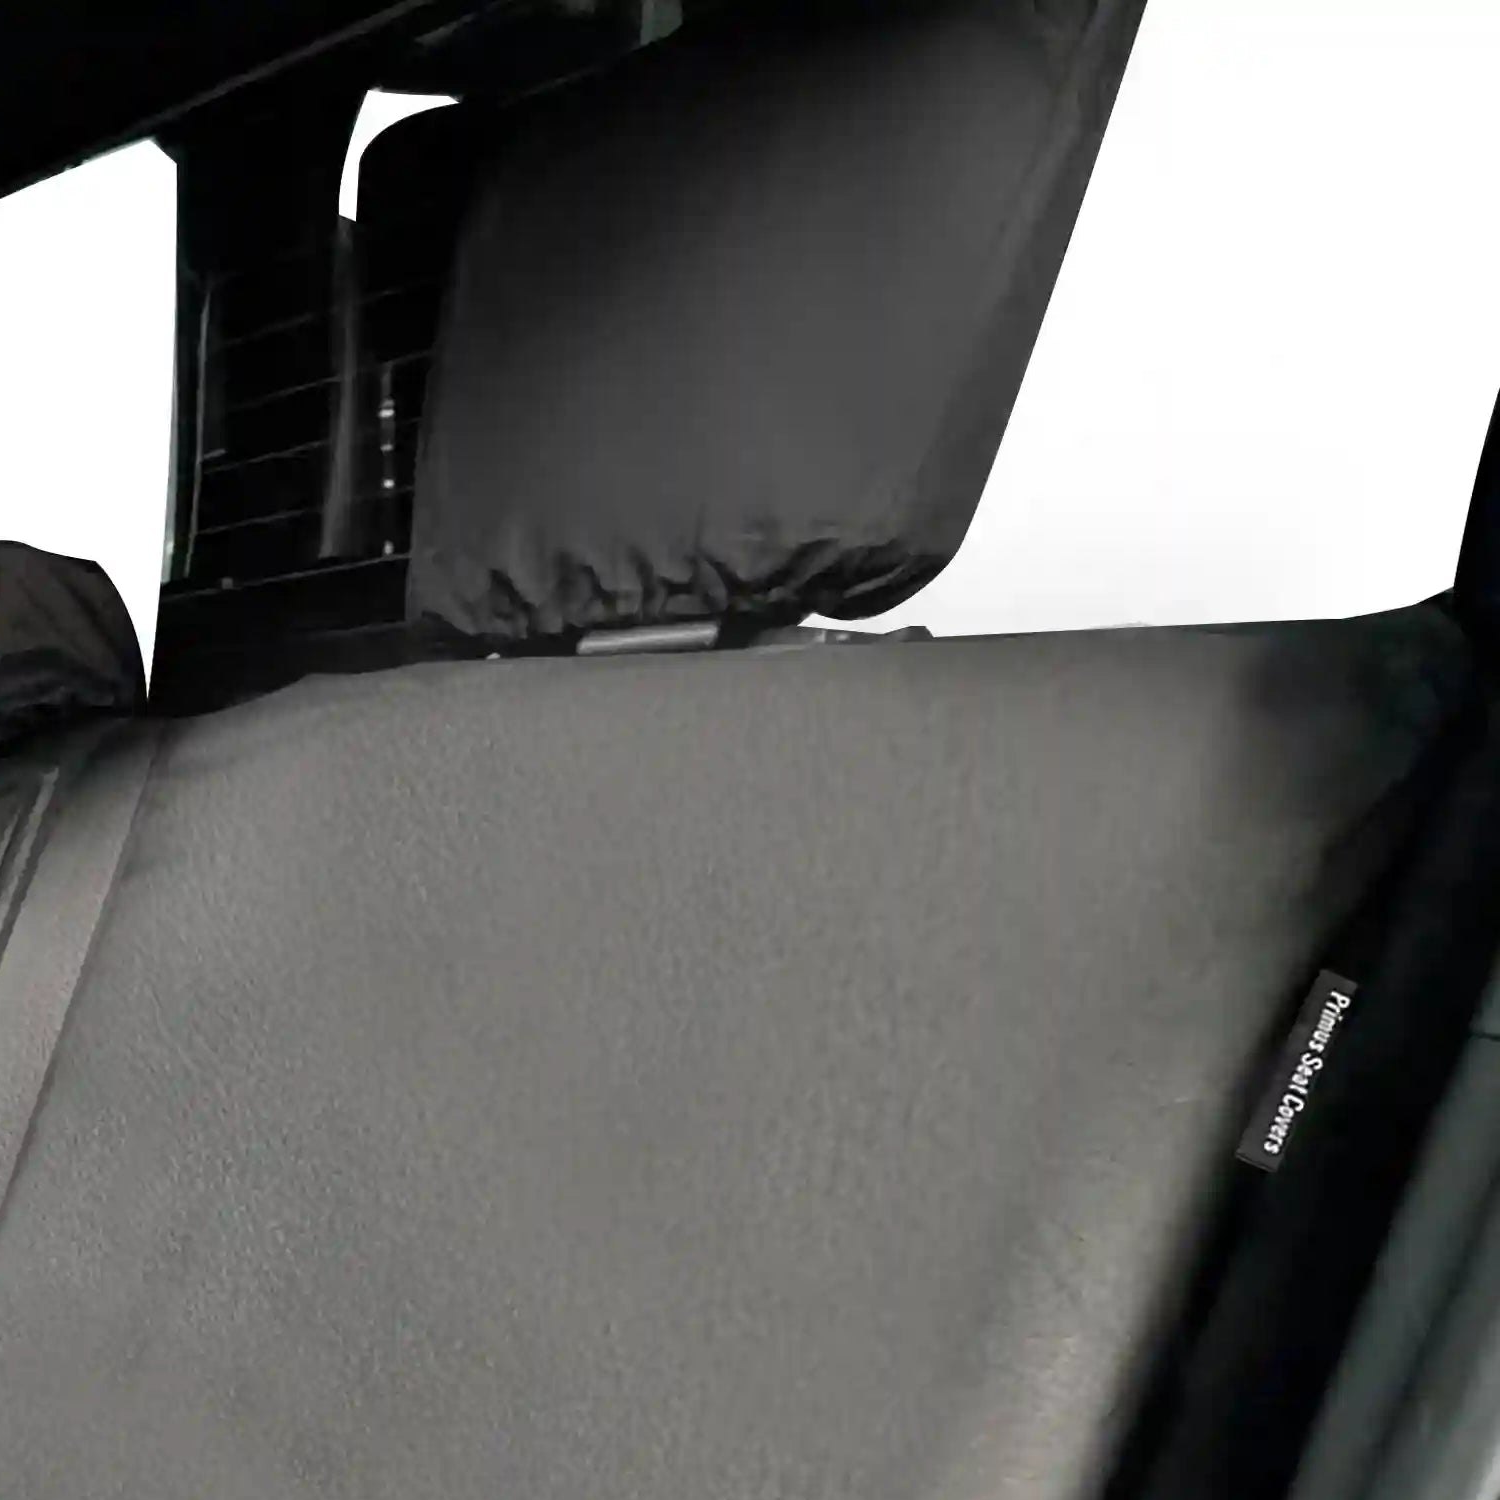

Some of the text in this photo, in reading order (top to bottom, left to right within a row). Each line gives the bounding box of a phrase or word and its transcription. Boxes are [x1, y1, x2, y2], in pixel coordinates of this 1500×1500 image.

[1263, 991, 1351, 1154] Primus Seat Covers
